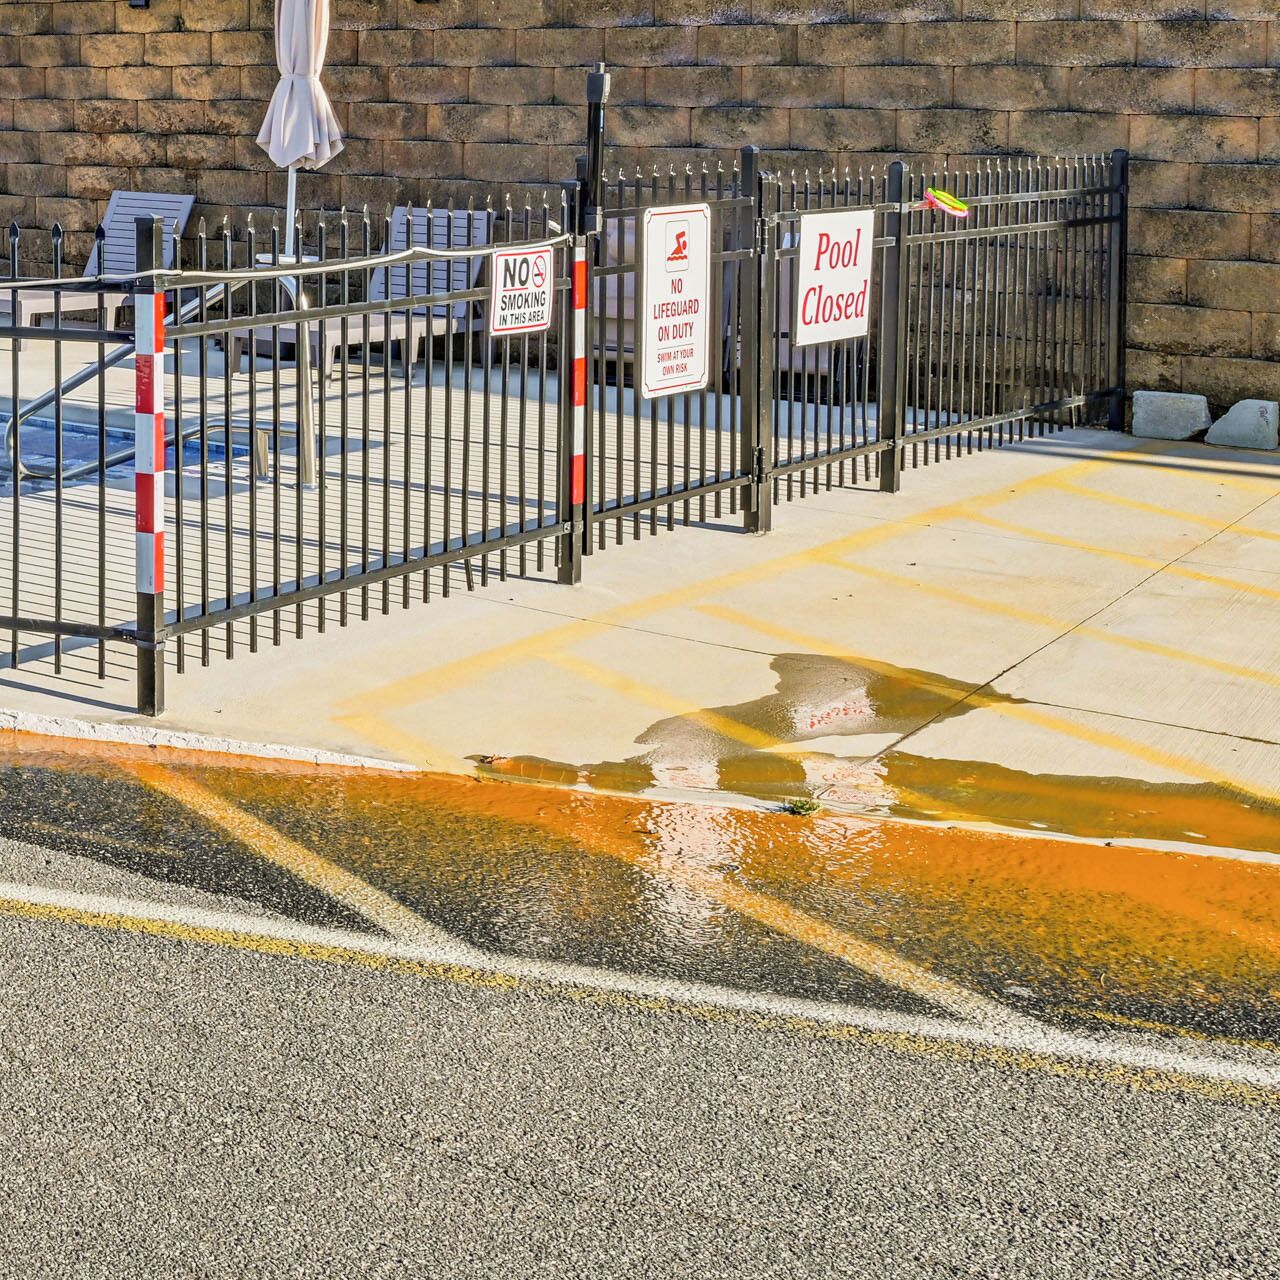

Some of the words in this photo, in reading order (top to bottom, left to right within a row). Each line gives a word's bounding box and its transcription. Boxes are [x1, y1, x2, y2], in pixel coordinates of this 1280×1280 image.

[814, 228, 861, 271] Pool
[503, 257, 530, 288] NO
[671, 278, 683, 294] NO
[501, 290, 546, 312] SMOKING
[653, 299, 700, 320] LIFEGUARD
[801, 279, 868, 326] Closed
[498, 313, 508, 326] IN
[510, 312, 527, 325] THIS
[528, 309, 545, 323] AREA
[658, 325, 670, 342] ON
[672, 321, 694, 340] DUTY
[657, 351, 672, 363] SWIM
[673, 350, 680, 360] AT
[680, 348, 694, 359] YOUR
[663, 365, 675, 376] OWN
[676, 363, 688, 373] RISK
